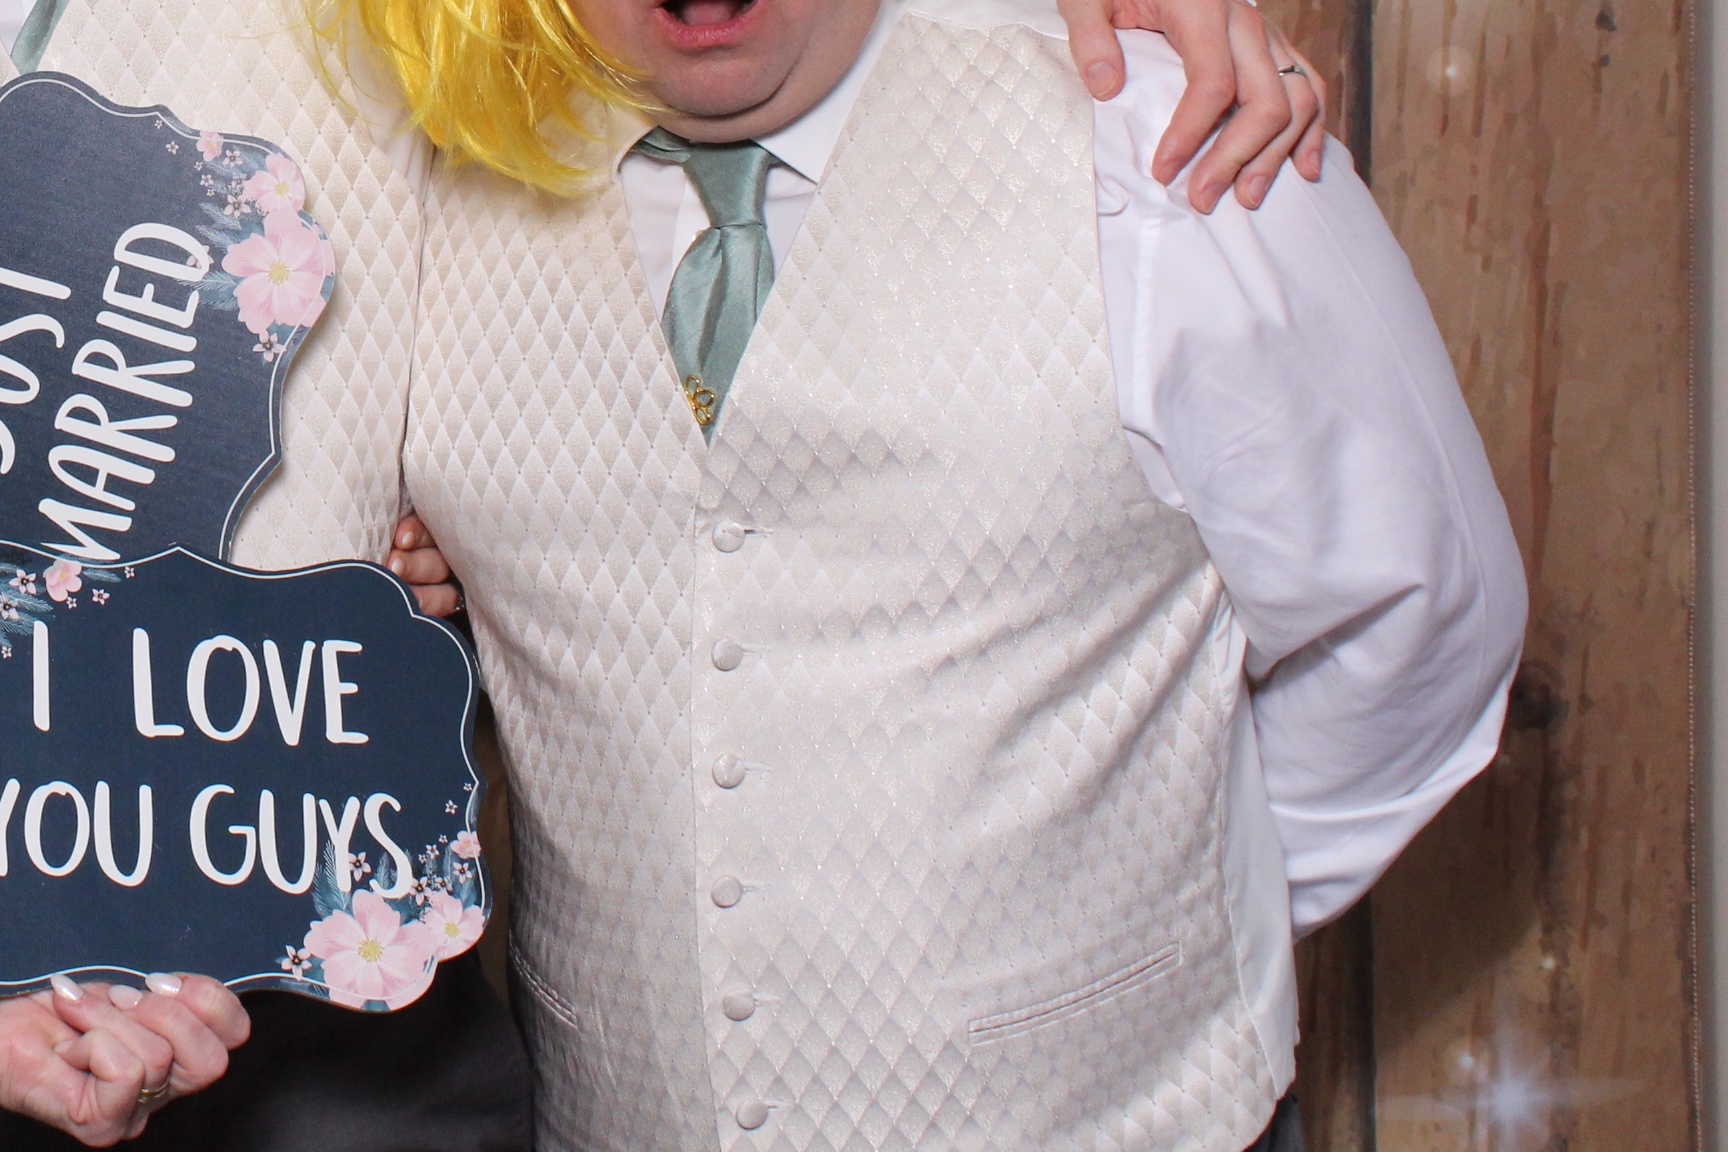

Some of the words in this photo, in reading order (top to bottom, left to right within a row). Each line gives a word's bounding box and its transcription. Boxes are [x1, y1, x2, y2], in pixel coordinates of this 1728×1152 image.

[38, 222, 211, 561] MARRIED
[32, 619, 50, 732] I
[132, 627, 369, 747] LOVE
[189, 783, 414, 900] GUYS
